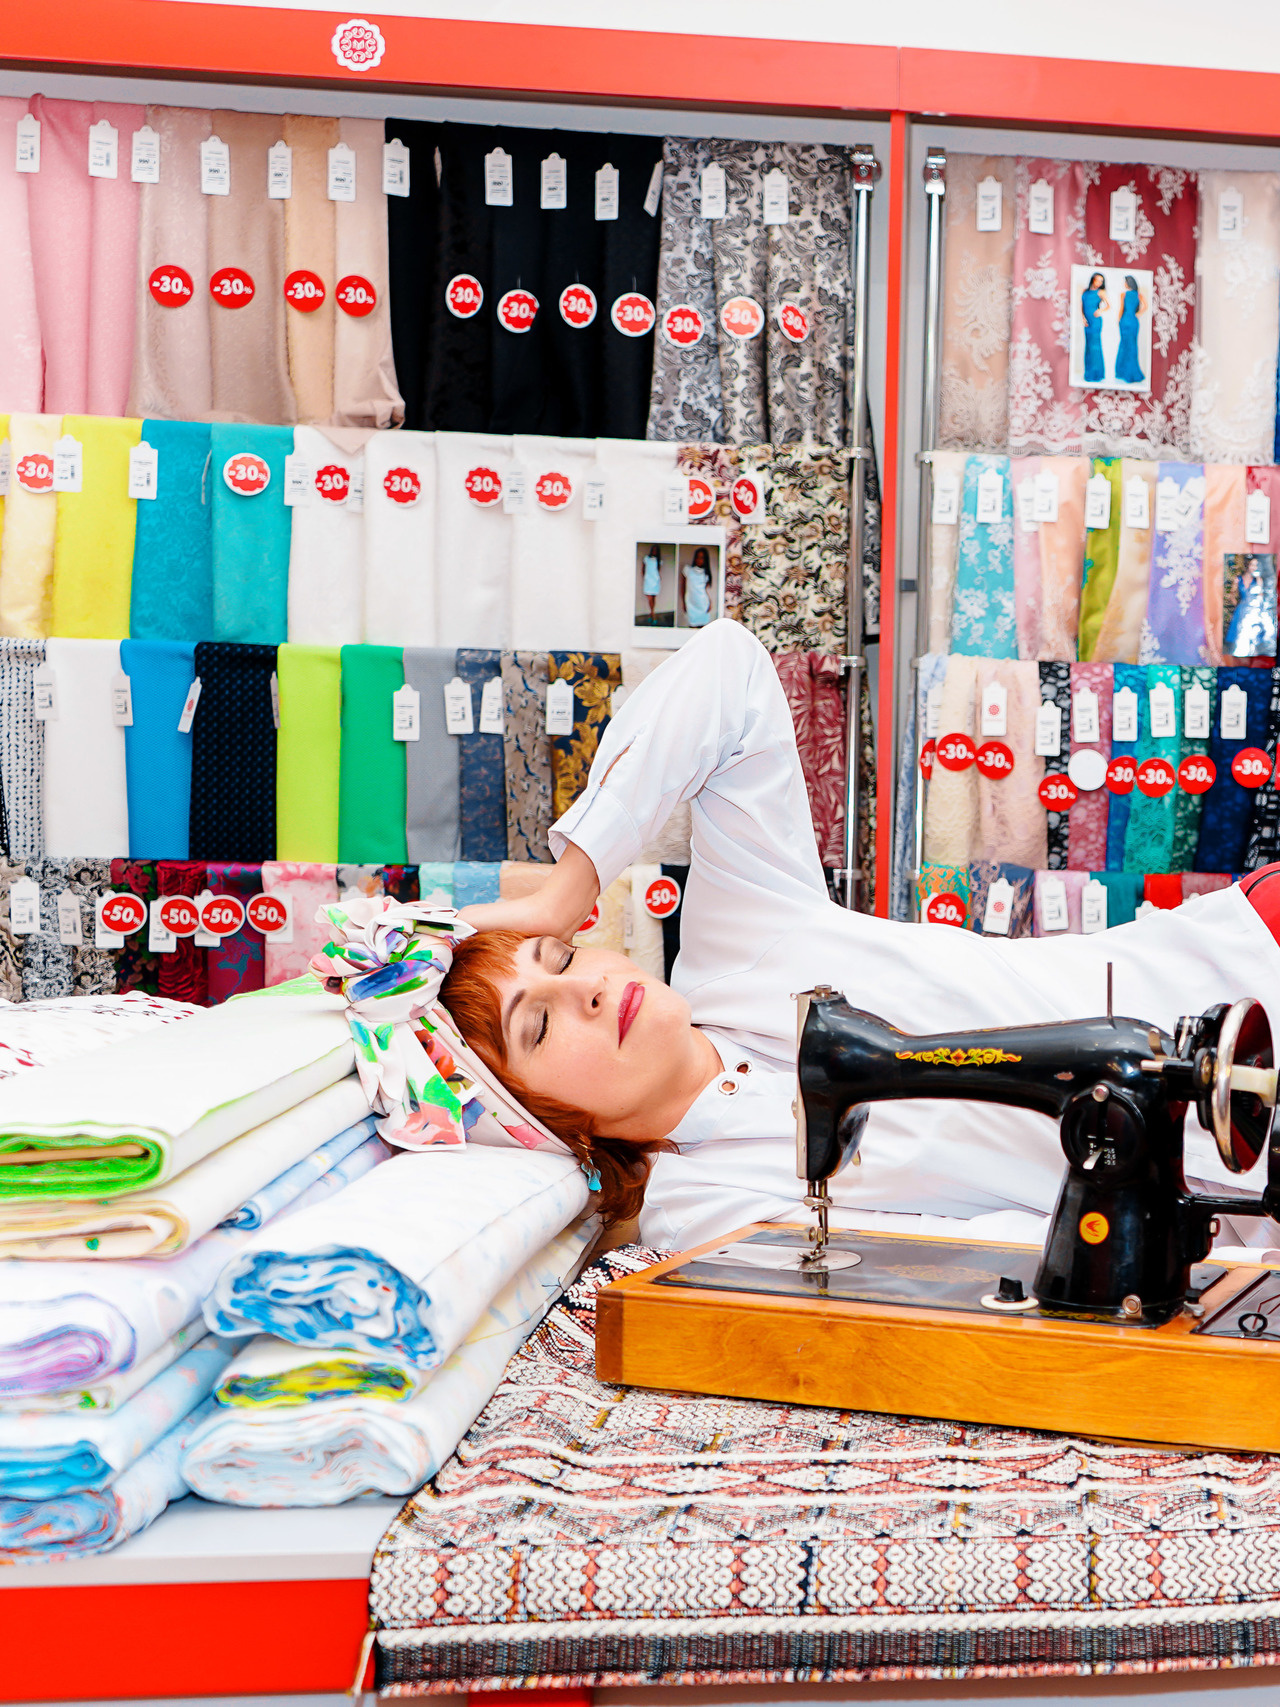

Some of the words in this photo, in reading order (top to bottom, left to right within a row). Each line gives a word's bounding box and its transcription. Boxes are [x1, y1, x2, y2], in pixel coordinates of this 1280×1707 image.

[152, 275, 190, 295] -30%
[213, 278, 252, 295] -30%
[287, 281, 323, 299] -30%
[337, 286, 373, 304] -30%
[450, 286, 480, 304] -30%
[503, 301, 535, 319] -30%
[562, 295, 592, 314] -30%
[617, 304, 651, 321] -30%
[667, 316, 701, 333] -30%
[723, 310, 758, 326] -30%
[228, 464, 268, 483] -30%
[385, 476, 420, 495] -30%
[464, 475, 501, 493] -30%
[536, 480, 570, 497] -30%
[939, 743, 974, 760] -30%
[977, 751, 1011, 769] -30%
[1180, 765, 1213, 783] -30%
[1235, 757, 1269, 776] -30%
[1139, 768, 1174, 785] -30%
[1040, 783, 1076, 800] -30%
[646, 887, 677, 906] -50%
[104, 904, 141, 927] -50%
[162, 908, 199, 926] -50%
[202, 908, 240, 927] -50%
[249, 904, 285, 925] -50%
[929, 903, 963, 922] -30%
